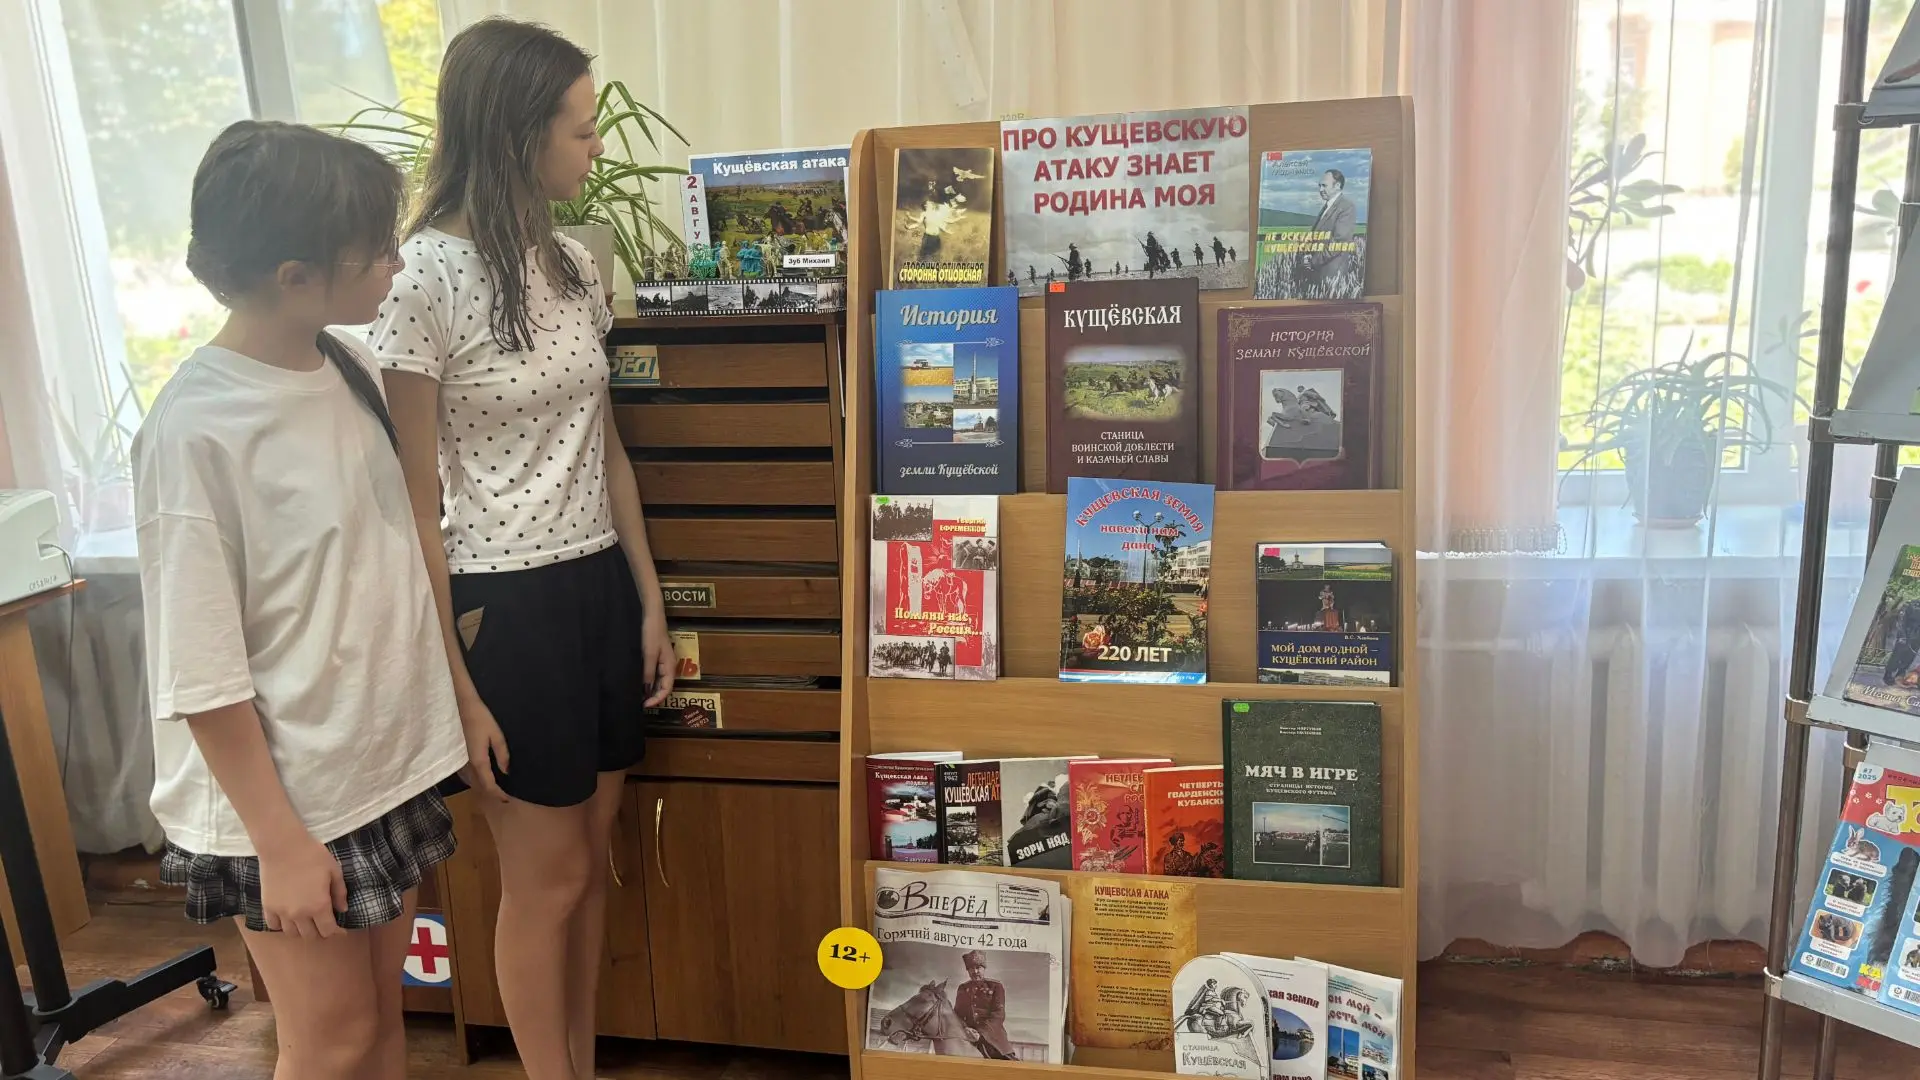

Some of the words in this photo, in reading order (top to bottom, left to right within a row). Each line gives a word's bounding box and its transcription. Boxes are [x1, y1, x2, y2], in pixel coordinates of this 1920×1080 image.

[1002, 127, 1057, 151] ПРО
[1065, 115, 1248, 148] КУЩЕВСКУЮ
[713, 160, 798, 177] Кущёвская
[802, 157, 847, 169] атака
[1033, 156, 1120, 182] АТАКУ
[1126, 151, 1215, 177] ЗНАЕТ
[686, 175, 698, 190] 2
[1033, 188, 1146, 216] РОДИНА
[1154, 183, 1215, 208] МОЯ
[788, 257, 801, 266] Зуб
[802, 256, 831, 265] Михаил
[900, 304, 998, 331] История
[1064, 303, 1182, 333] КУЩЁВСКАЯ
[1270, 330, 1335, 344] ИСТОРИЯ
[1236, 348, 1281, 360] ЗЕМЛИ
[1287, 344, 1370, 359] КУЩЁВСКОЙ
[1101, 431, 1144, 440] СТАНИЦА
[1071, 442, 1122, 453] ВОИНСКОЙ
[1124, 442, 1174, 452] ДОБЛЕСТИ
[1077, 455, 1084, 463] И
[1086, 453, 1133, 464] КАЗАЧЬЕЙ
[1135, 454, 1169, 463] СЛАВЫ
[900, 464, 936, 477] земли
[938, 463, 999, 477] Кущёвской
[1075, 487, 1161, 527] КУЩЕВСКАЯ
[1163, 494, 1205, 534] ЗЕМЛЯ
[1100, 524, 1148, 535] навеки
[1151, 526, 1179, 537] нам
[895, 607, 944, 620] Помяни
[1097, 647, 1131, 662] 220
[1135, 647, 1172, 663] ЛЕТ
[1271, 643, 1295, 653] МОЙ
[1298, 645, 1321, 654] ДОМ
[1324, 644, 1368, 655] РОДНОЙ
[1272, 655, 1337, 666] КУЩЁВСКИЙ
[1341, 656, 1377, 666] РАЙОН
[1245, 765, 1287, 778] МЯЧ
[1291, 767, 1304, 779] В
[1309, 767, 1358, 781] ИГРЕ
[944, 783, 990, 807] КУЩЁВСКАЯ
[1016, 840, 1045, 860] ЗОРИ
[1046, 832, 1070, 850] НАД
[1094, 886, 1141, 898] КУЩЕВСКАЯ
[1144, 889, 1169, 899] АТАКА
[877, 927, 931, 943] Горячий
[934, 932, 975, 947] август
[978, 934, 993, 947] 42
[998, 937, 1027, 949] года
[829, 943, 871, 964] 12+
[1286, 993, 1320, 1008] земля
[1346, 999, 1371, 1015] мой
[1328, 1010, 1358, 1024] ость
[1362, 1021, 1387, 1039] моя
